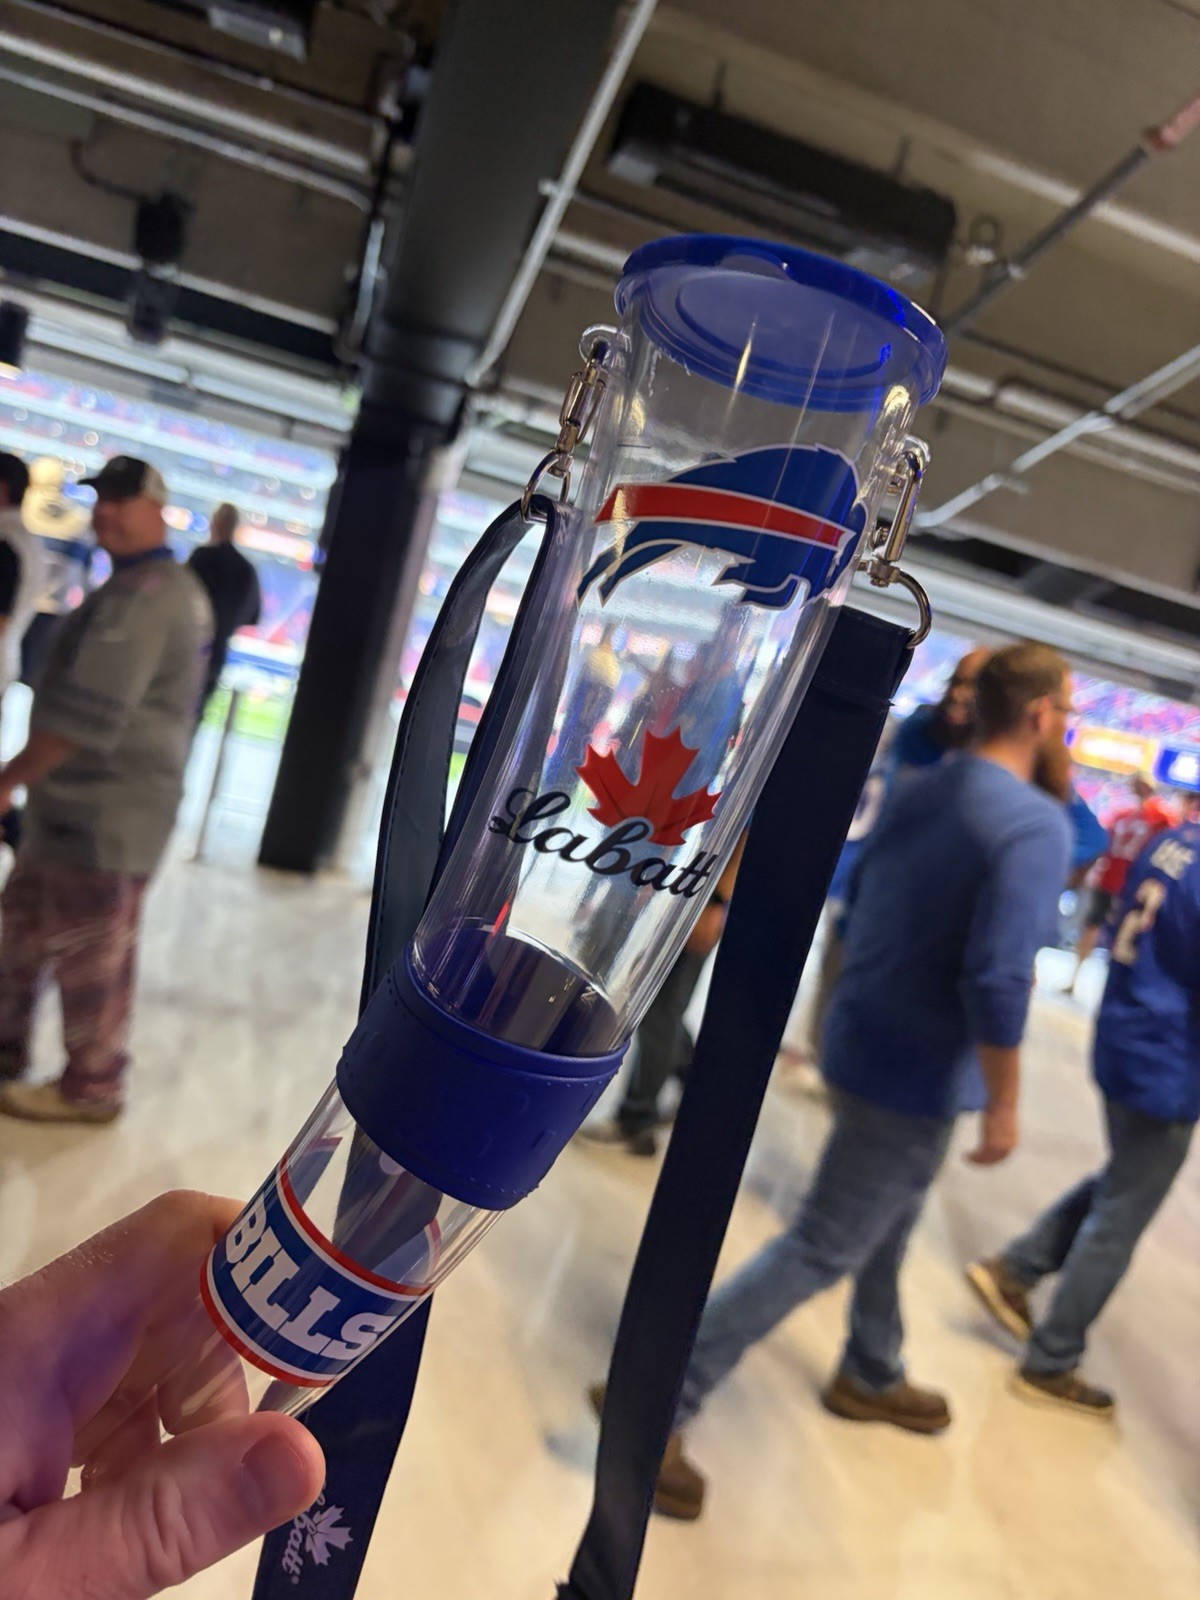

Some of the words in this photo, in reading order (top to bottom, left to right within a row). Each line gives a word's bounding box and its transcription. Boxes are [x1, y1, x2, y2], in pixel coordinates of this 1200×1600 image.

[488, 787, 718, 898] Labatt
[225, 1193, 399, 1361] BILLS
[282, 1484, 326, 1576] batt
